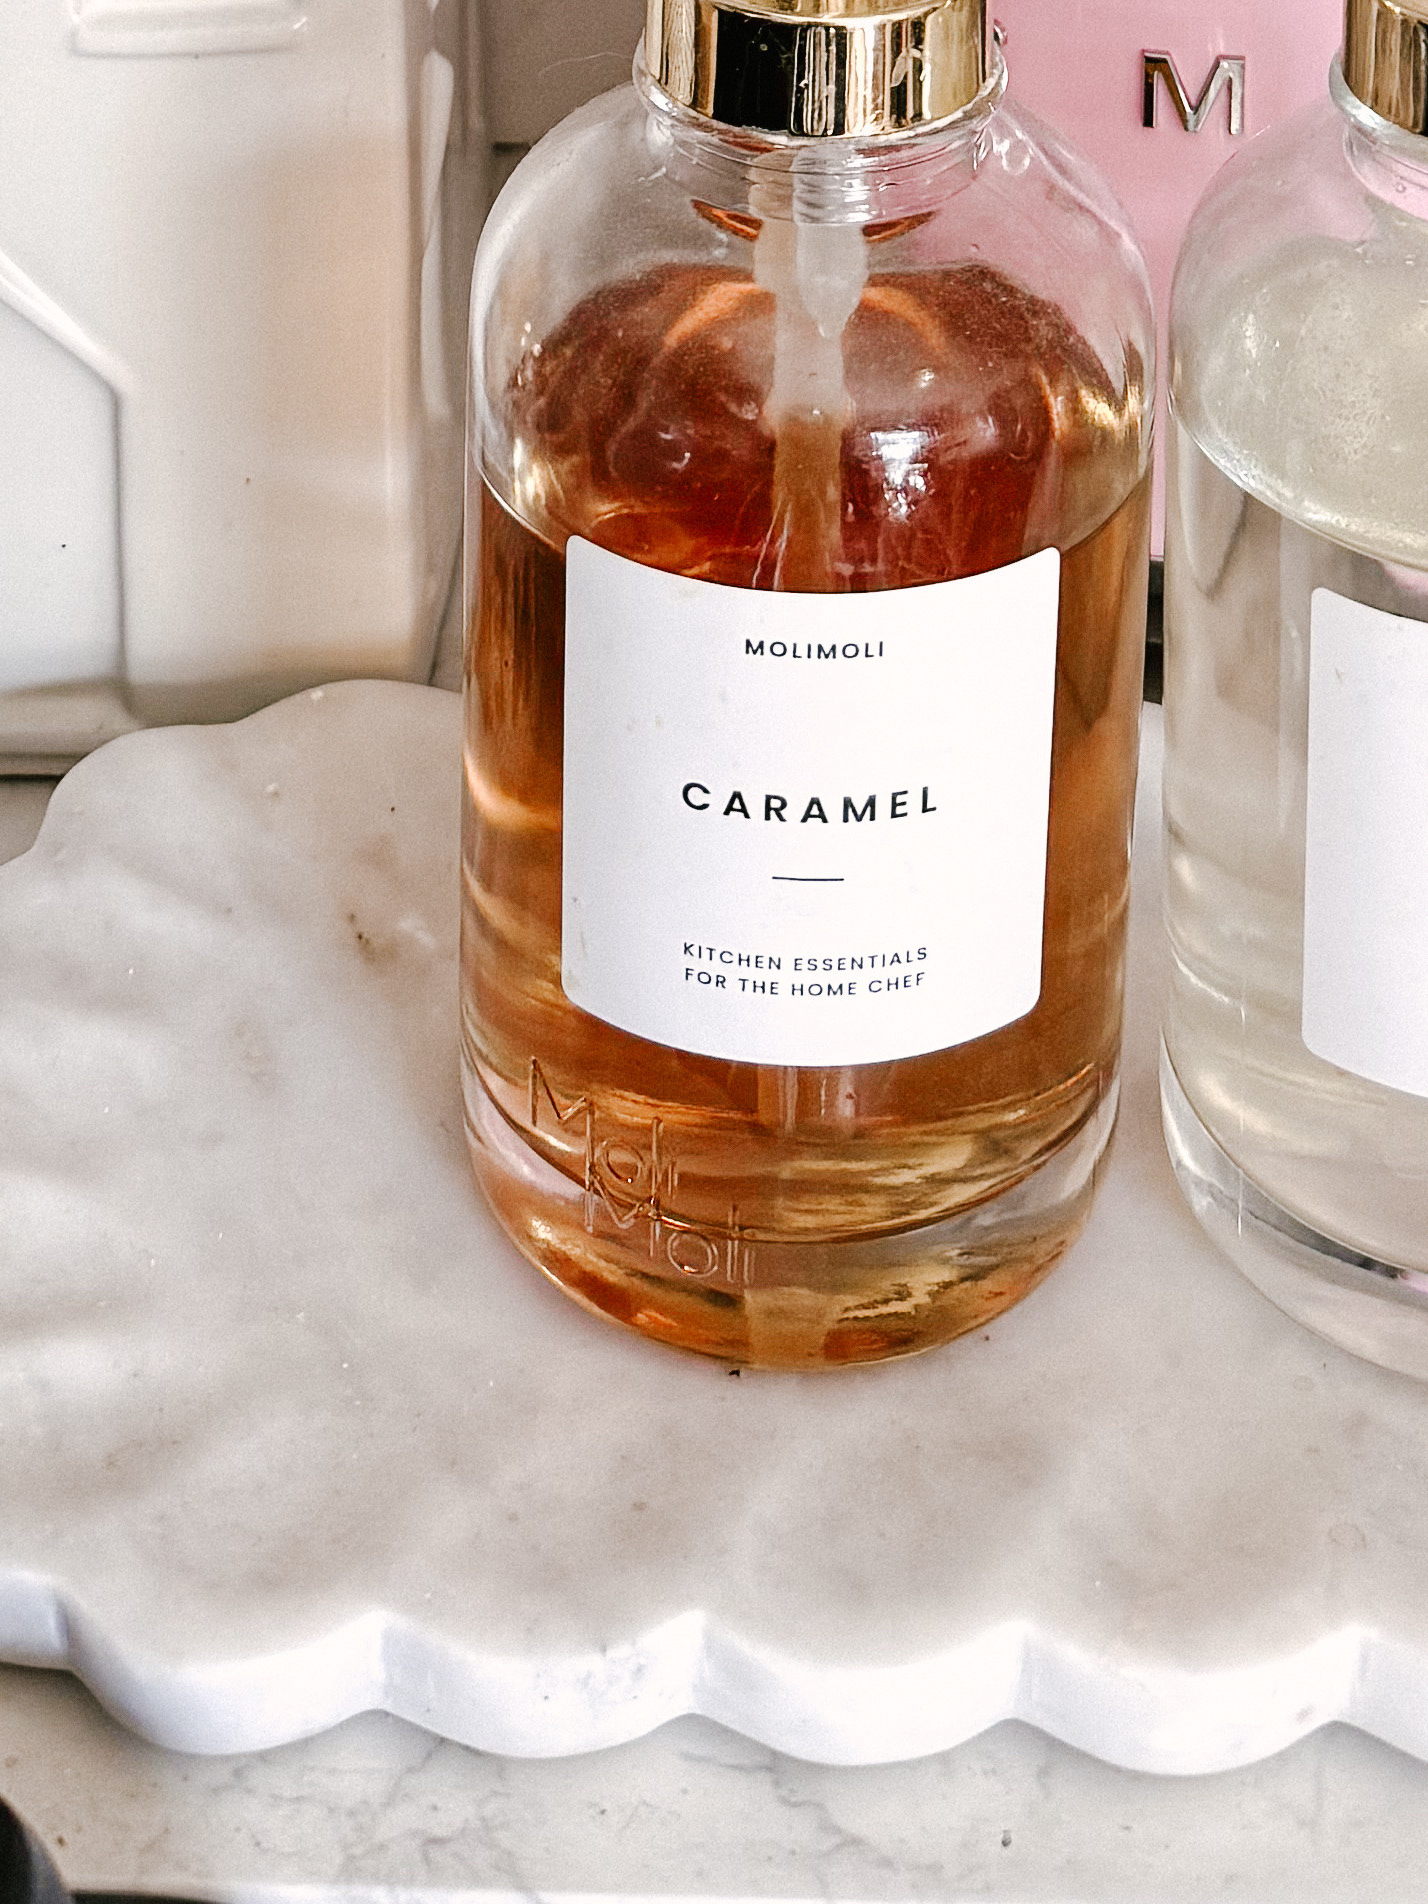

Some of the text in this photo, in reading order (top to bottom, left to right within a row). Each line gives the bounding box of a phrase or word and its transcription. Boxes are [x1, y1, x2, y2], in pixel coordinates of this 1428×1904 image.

[744, 637, 885, 660] MOLIMOLI
[681, 781, 939, 825] CARAMEL
[682, 941, 929, 973] KITCHEN ESSENTIALS
[683, 967, 927, 998] FOR THE HOME CHEF
